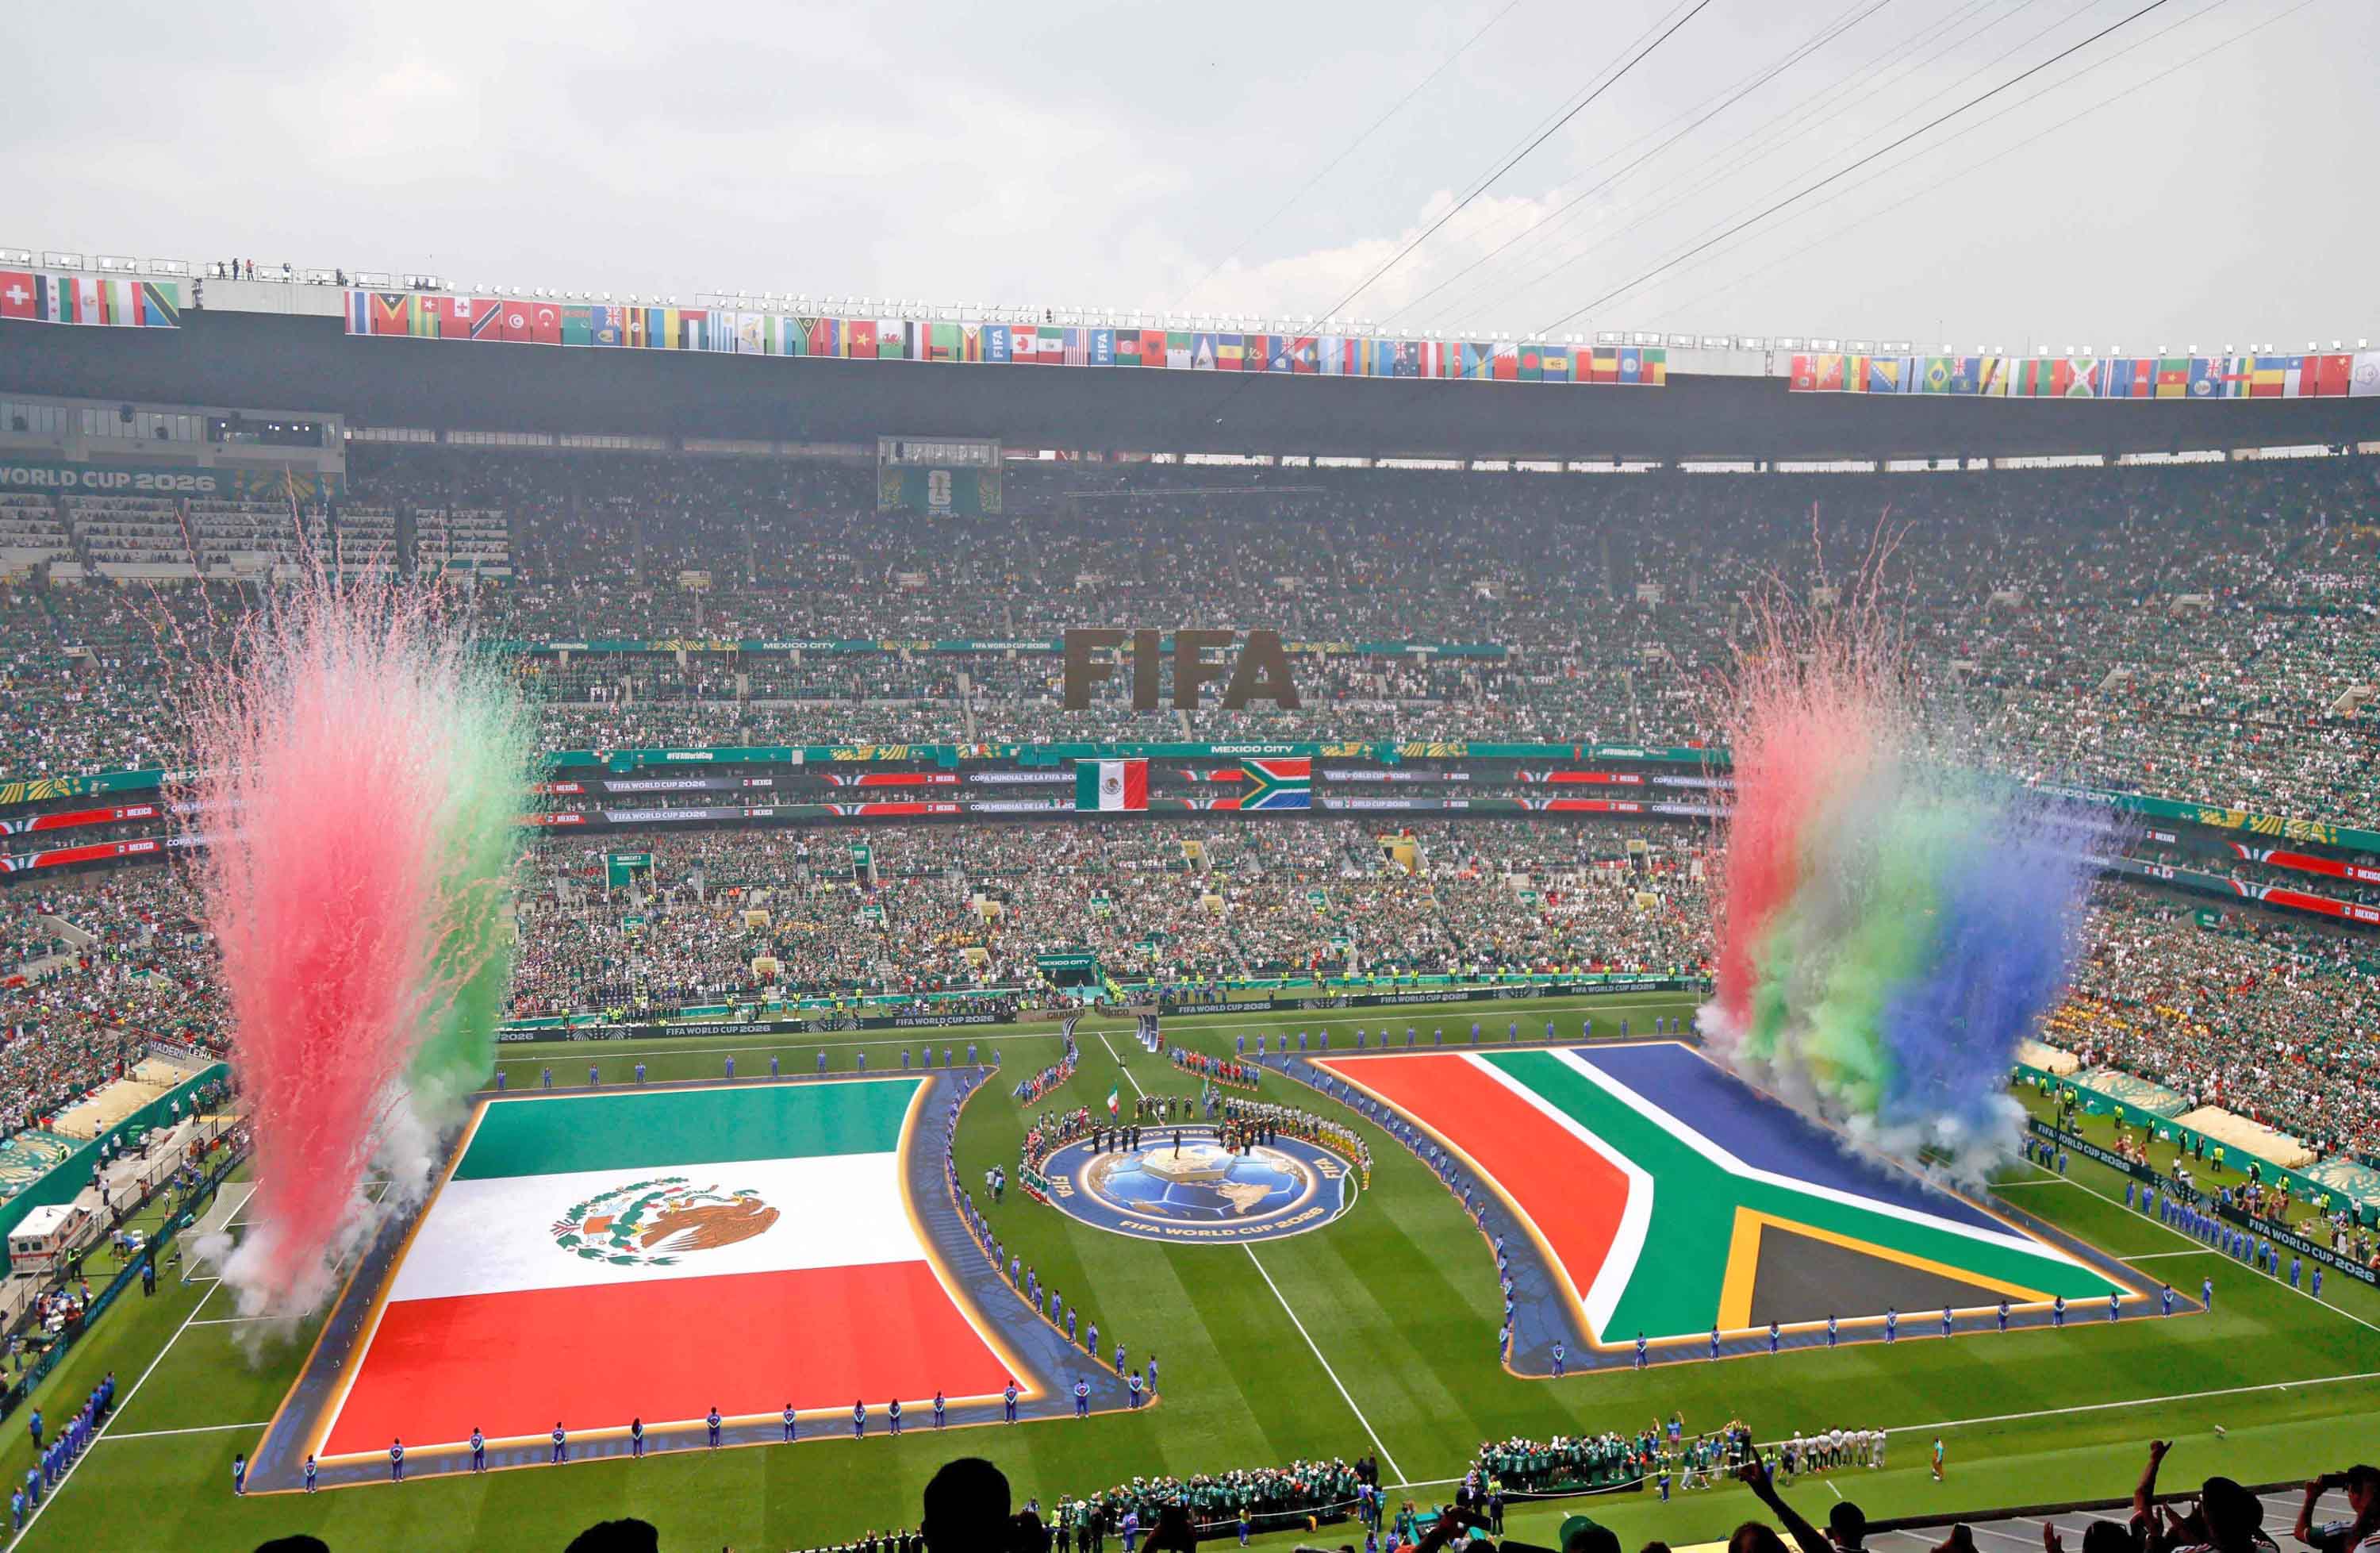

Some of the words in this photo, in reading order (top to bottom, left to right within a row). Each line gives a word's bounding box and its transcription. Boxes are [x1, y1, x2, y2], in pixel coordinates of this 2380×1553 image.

[992, 329, 1004, 358] FIFA
[1098, 333, 1108, 362] FIFA
[83, 471, 130, 488] CUP
[135, 474, 217, 490] 2026
[1064, 629, 1301, 710] FIFA
[2086, 792, 2117, 803] CITY
[127, 807, 152, 817] MEXICO
[129, 842, 154, 851] MEXICO
[167, 836, 191, 847] COPA
[2155, 833, 2175, 844] MEXICO
[2355, 909, 2379, 921] MEXICO
[686, 1026, 719, 1035] WORLD
[2038, 1124, 2055, 1137] FIFA
[2083, 1144, 2100, 1157] CUP
[2100, 1152, 2131, 1172] 2026
[1314, 1158, 1342, 1178] FIFA
[1050, 1175, 1075, 1197] FIFA
[1119, 1220, 1160, 1233] FIFA
[1166, 1227, 1235, 1236] WORLD
[1239, 1224, 1273, 1235] CUP
[1276, 1206, 1325, 1228] 2026
[2249, 1219, 2270, 1236] FIFA
[2272, 1228, 2310, 1253] WORLD
[2312, 1247, 2334, 1263] CUP
[2335, 1257, 2376, 1283] 2026
